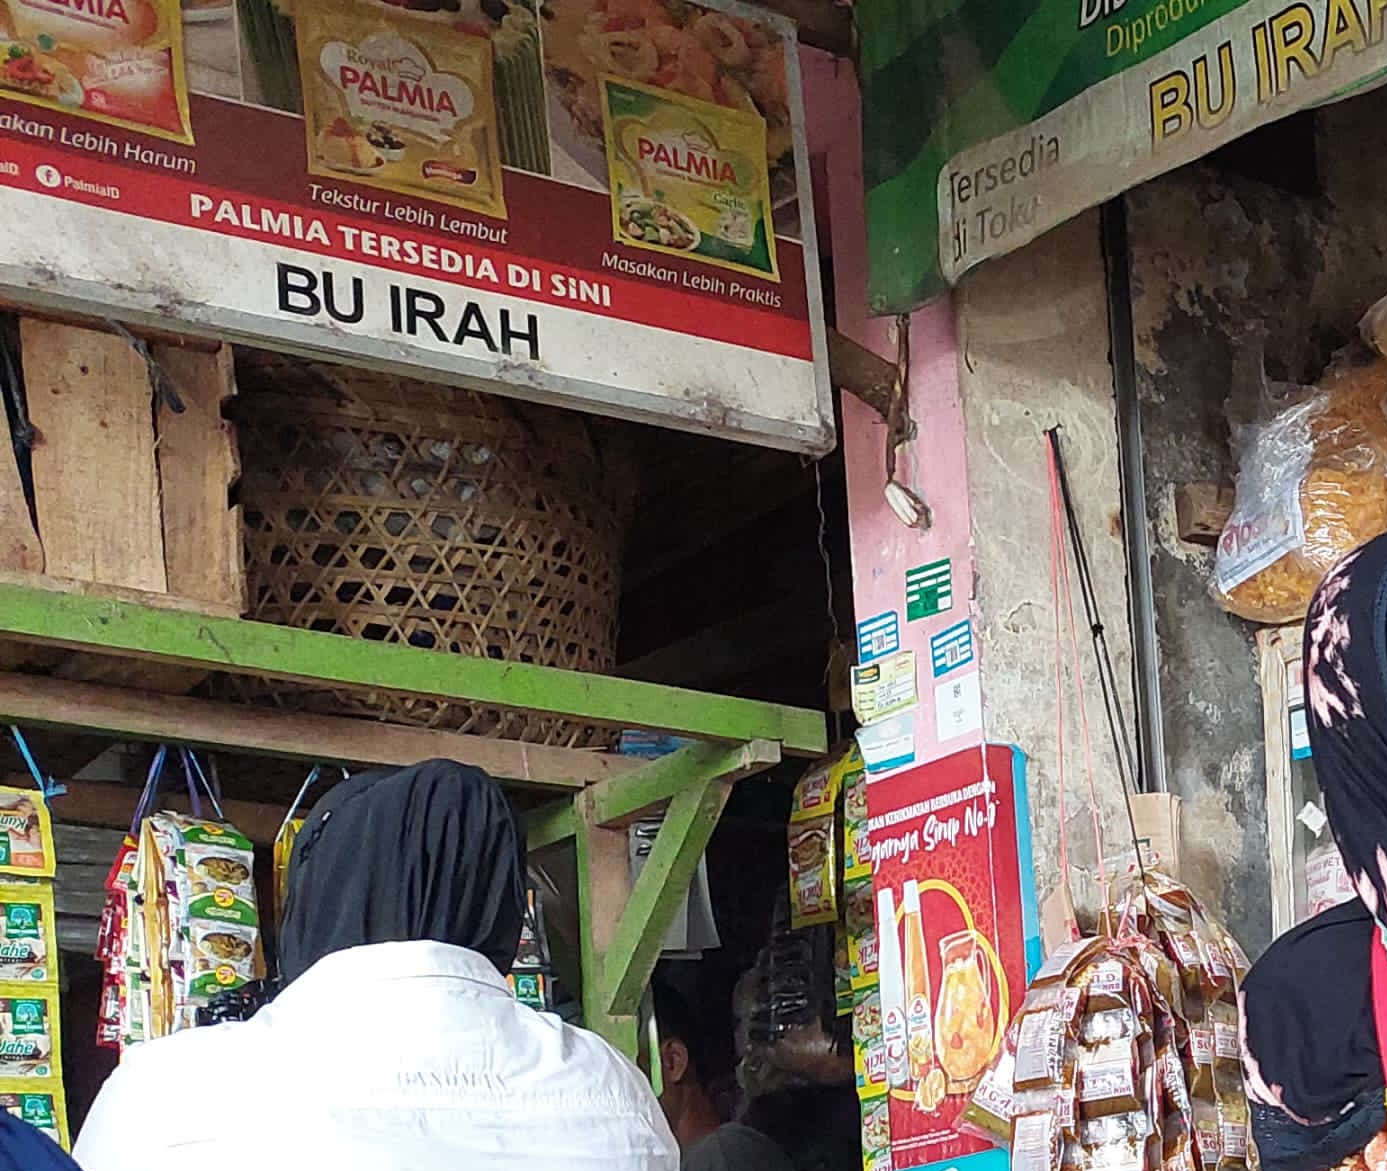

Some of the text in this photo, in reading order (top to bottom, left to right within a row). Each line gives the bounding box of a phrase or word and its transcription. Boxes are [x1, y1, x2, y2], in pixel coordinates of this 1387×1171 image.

[1106, 0, 1206, 57] Diprodu
[339, 65, 458, 117] PALMIA
[1149, 40, 1238, 150] BU
[0, 113, 197, 175] akan Lebih Harum
[637, 137, 737, 185] PALMIA
[949, 136, 1061, 208] Tersedia
[189, 192, 333, 246] PALMIA
[336, 223, 502, 283] TERSEDIA
[506, 262, 544, 293] DI
[308, 183, 509, 245] Tekstur Lebih Lembut
[953, 219, 968, 262] di
[601, 251, 783, 309] Masakan Lebih Praktis
[276, 261, 541, 361] BU IRAH
[0, 815, 29, 832] Kun
[922, 813, 960, 852] Sirup
[0, 943, 29, 959] ahe
